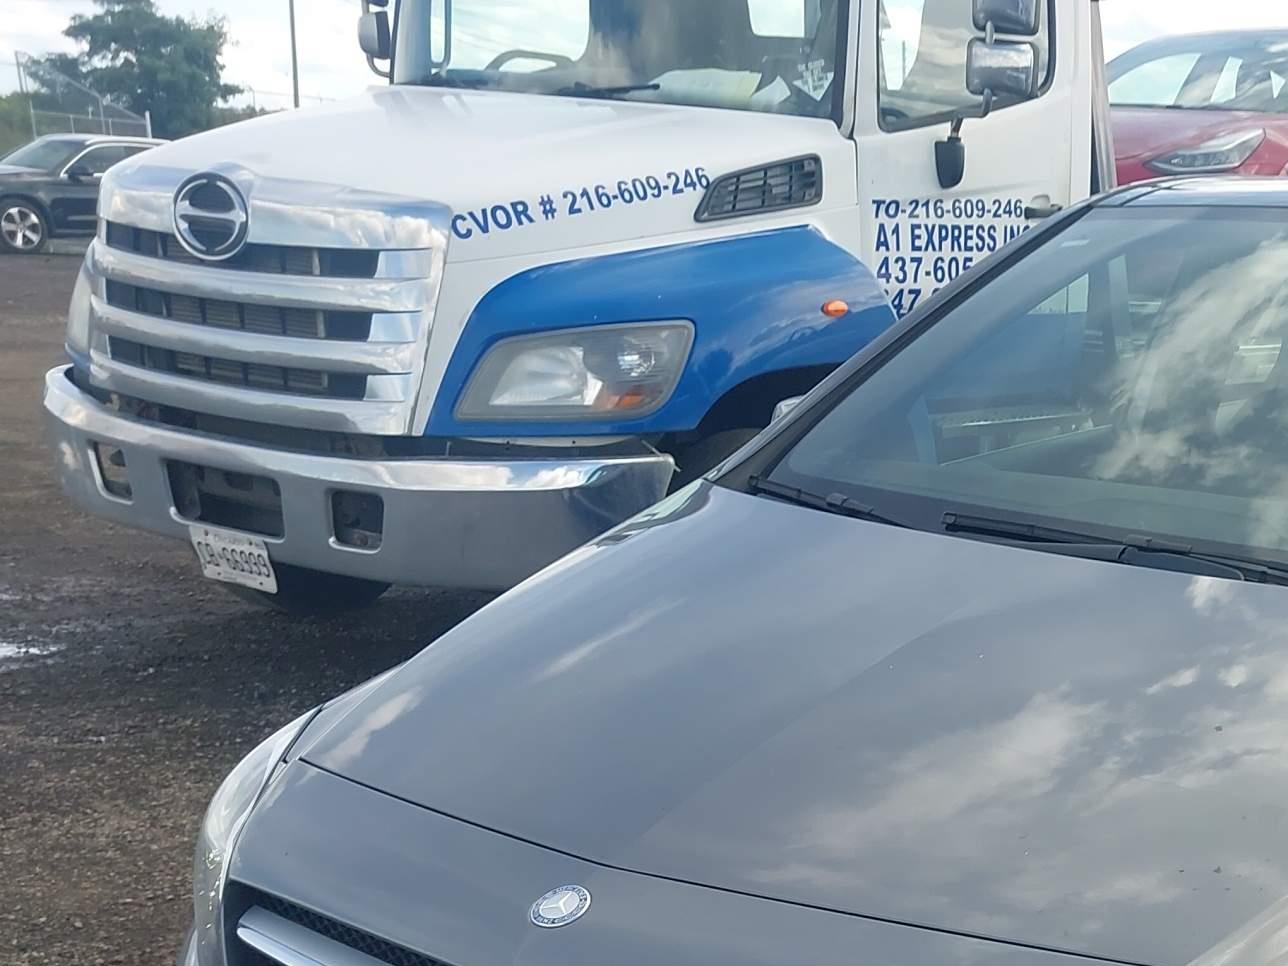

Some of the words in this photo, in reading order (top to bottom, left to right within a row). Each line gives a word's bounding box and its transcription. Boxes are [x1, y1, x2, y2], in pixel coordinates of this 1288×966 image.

[451, 200, 535, 239] CVOR
[563, 167, 710, 215] 216-609-246
[875, 223, 901, 252] A1
[910, 224, 997, 253] EXPRESS
[1004, 225, 1030, 246] IN
